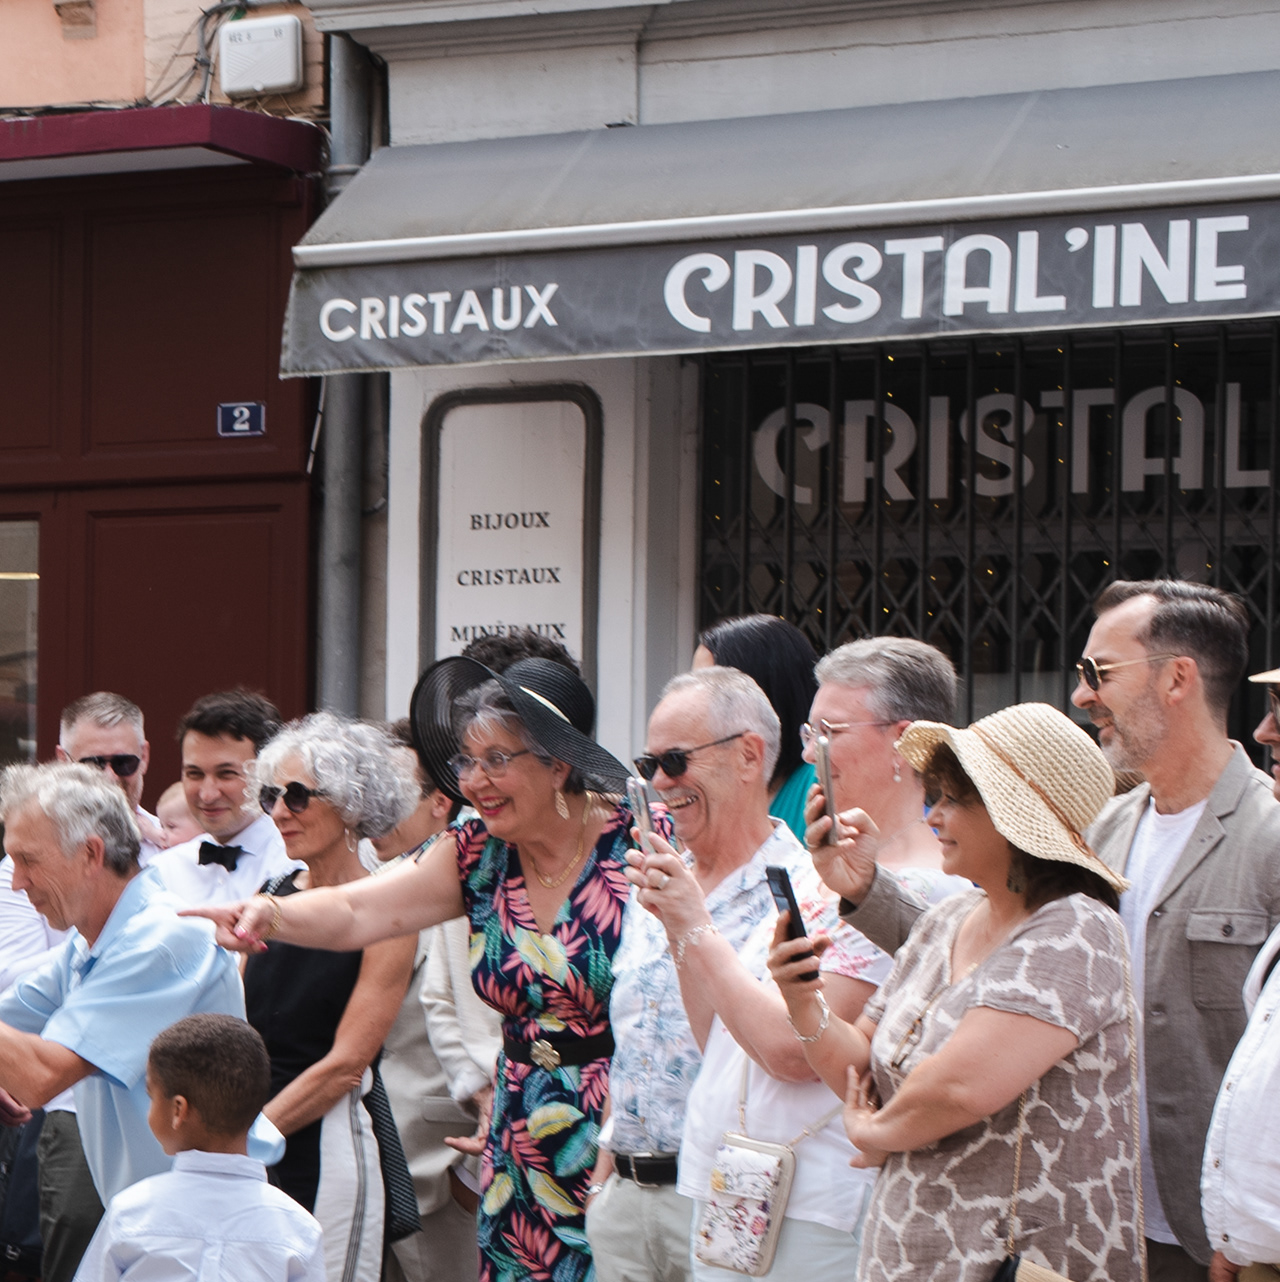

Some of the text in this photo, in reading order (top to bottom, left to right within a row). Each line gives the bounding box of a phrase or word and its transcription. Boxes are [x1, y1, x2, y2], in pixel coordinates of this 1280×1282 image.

[663, 214, 1251, 333] CRISTAL'INE
[319, 283, 559, 342] CRISTAUX
[232, 406, 251, 431] 2
[470, 512, 550, 530] BIJOUX
[457, 567, 561, 586] CRISTAUX
